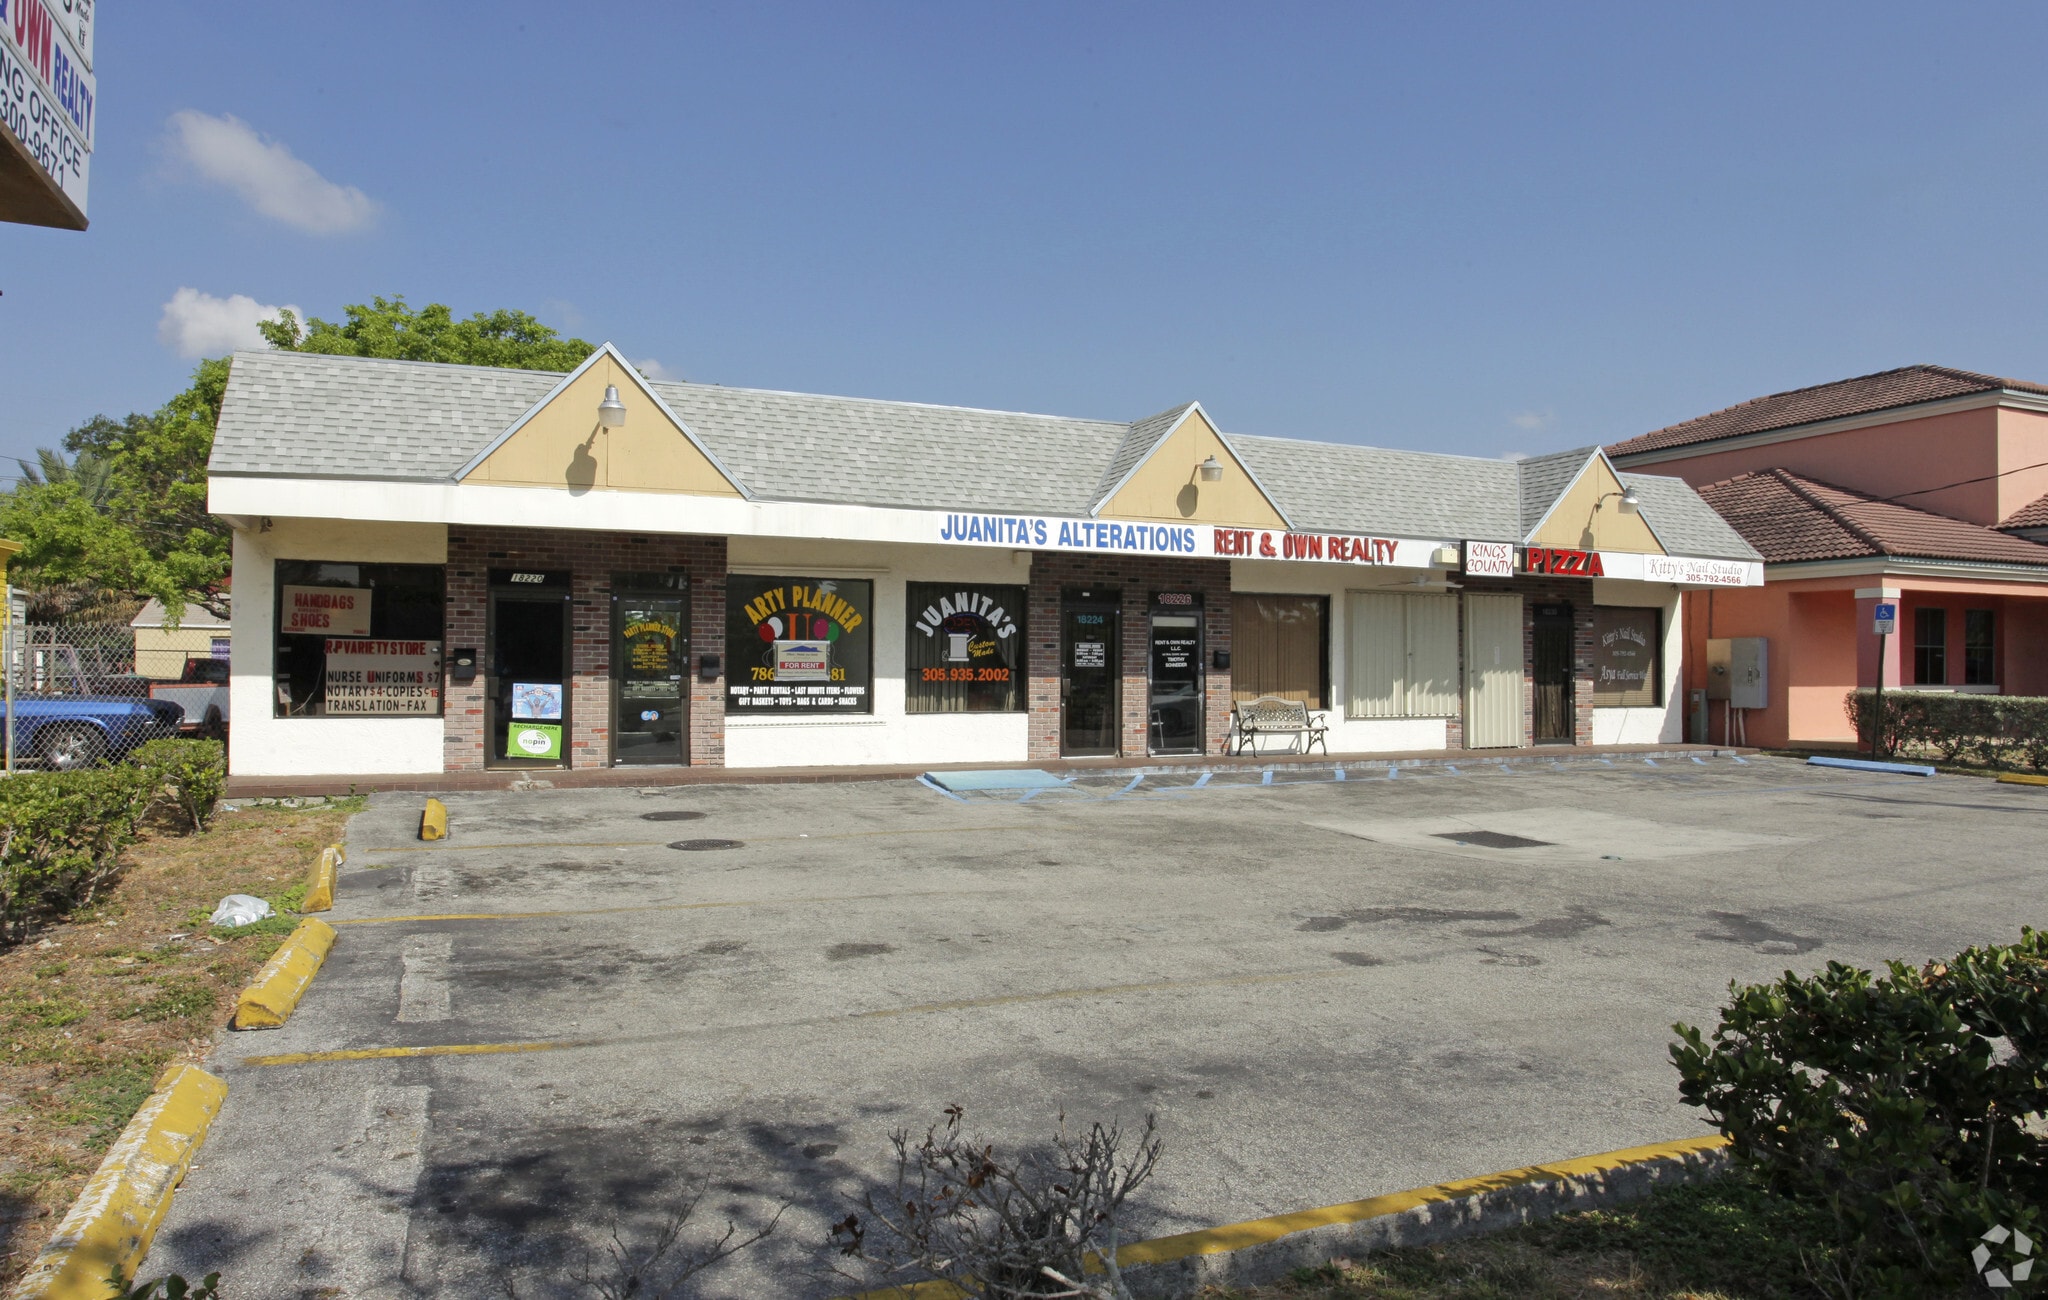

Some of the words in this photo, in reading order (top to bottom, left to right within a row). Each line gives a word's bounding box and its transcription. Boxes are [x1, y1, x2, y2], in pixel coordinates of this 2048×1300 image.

[54, 42, 93, 141] REALTY
[29, 90, 81, 178] OFFICE
[941, 514, 1048, 545] JUANITA'S
[1058, 521, 1196, 552] ALTERATIONS
[1213, 529, 1254, 556] RENT
[1259, 532, 1277, 557] &
[1282, 533, 1323, 559] OWN
[1328, 537, 1399, 563] REALTY
[1471, 543, 1507, 560] KINGS
[1466, 559, 1514, 574] COUNTY
[1527, 547, 1605, 577] PIZZA
[1649, 558, 1684, 580] Kitty's
[1686, 561, 1709, 574] Nail
[1710, 562, 1743, 576] Studio
[511, 574, 545, 583] 18220
[1685, 573, 1742, 585] 305-792-4566
[294, 592, 354, 610] HANDBAGS
[1158, 593, 1193, 605] 18226
[744, 587, 786, 625] ARTY
[792, 586, 863, 634] PLANNER
[915, 592, 1017, 639] JUANITA'S
[291, 612, 330, 628] SHOES
[1077, 615, 1104, 624] 18224
[343, 640, 389, 655] VARIETY
[390, 641, 427, 656] STORE
[968, 640, 996, 652] Custom
[972, 648, 994, 658] Made
[327, 671, 361, 683] NURSE
[367, 671, 424, 684] UNIFORMS
[922, 668, 1010, 681] 305.935.2002
[327, 685, 369, 697] NOTARY
[753, 686, 769, 695] PARTY
[770, 686, 791, 695] RENTALS
[794, 686, 806, 695] LAST
[826, 686, 841, 695] ITEMS
[844, 686, 865, 695] FLOWERS
[738, 697, 750, 705] GIFT
[752, 697, 774, 705] BASKETS
[778, 697, 792, 705] TOYS
[796, 697, 810, 705] BAGS
[811, 697, 816, 705] &
[818, 697, 834, 705] CARDS
[522, 738, 546, 746] nopin
